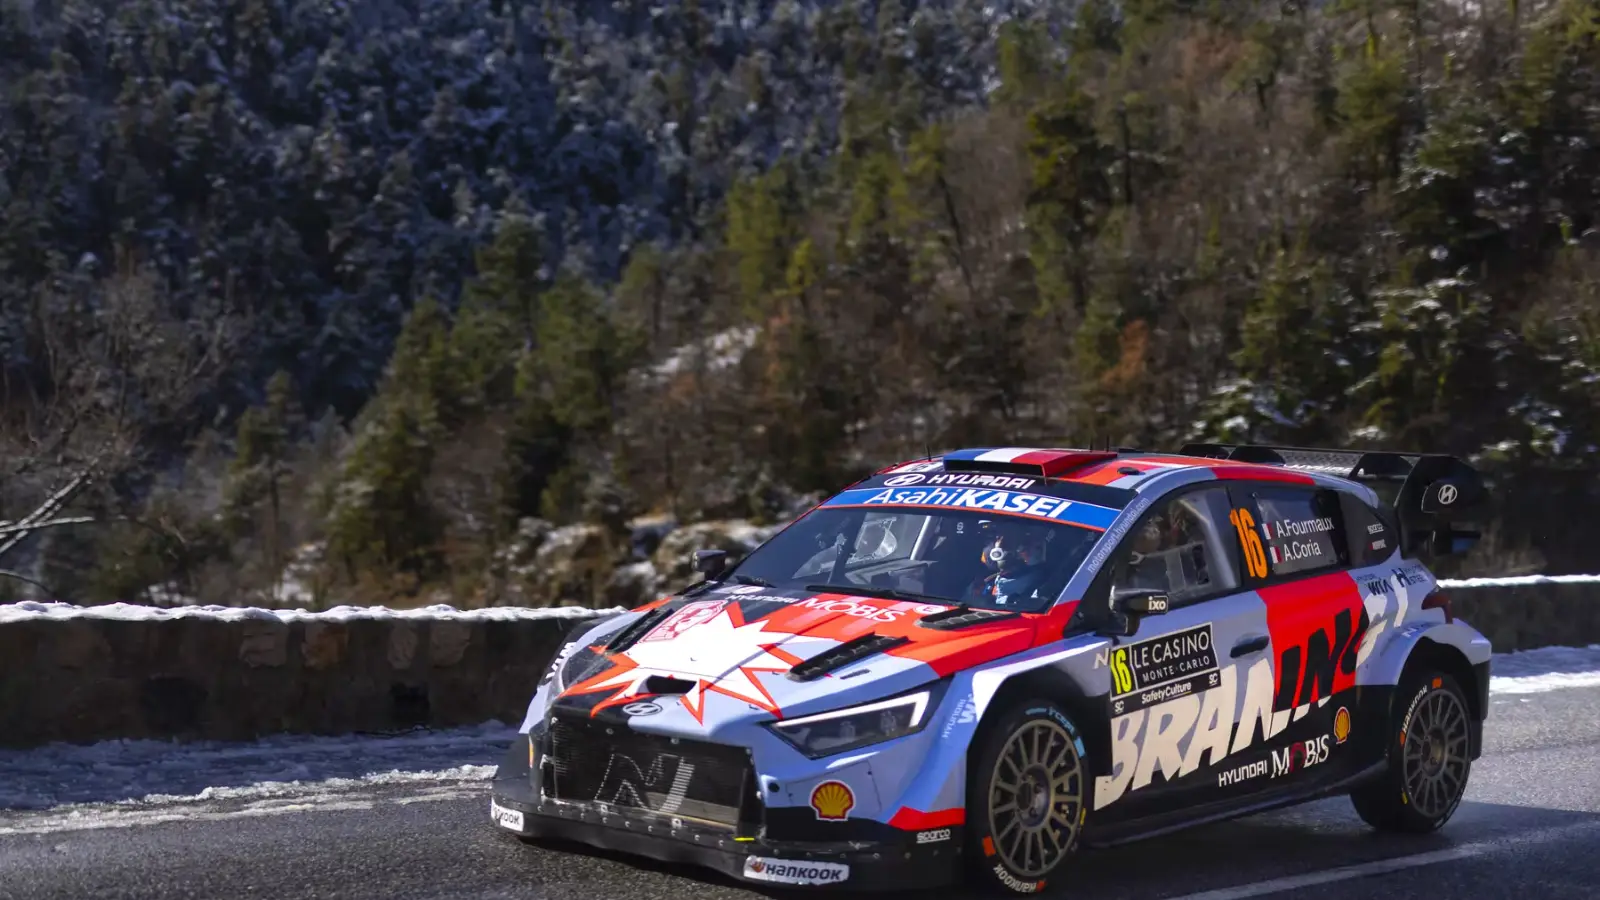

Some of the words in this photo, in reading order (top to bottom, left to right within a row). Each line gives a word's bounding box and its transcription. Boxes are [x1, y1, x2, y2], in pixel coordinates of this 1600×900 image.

[927, 474, 1036, 490] HYUNDAI
[1275, 517, 1335, 538] A.Fourmaux
[1229, 507, 1268, 579] 16
[1283, 539, 1322, 562] A.Coria
[794, 597, 905, 622] MOBIS
[1148, 595, 1167, 611] ixo
[1134, 646, 1149, 669] LE
[1152, 631, 1209, 664] CASINO
[1110, 649, 1132, 695] 16
[1142, 681, 1192, 704] SafetyCulture
[1218, 760, 1268, 788] HYUNDAI
[1268, 734, 1330, 779] MOBIS
[917, 828, 951, 843] sparco
